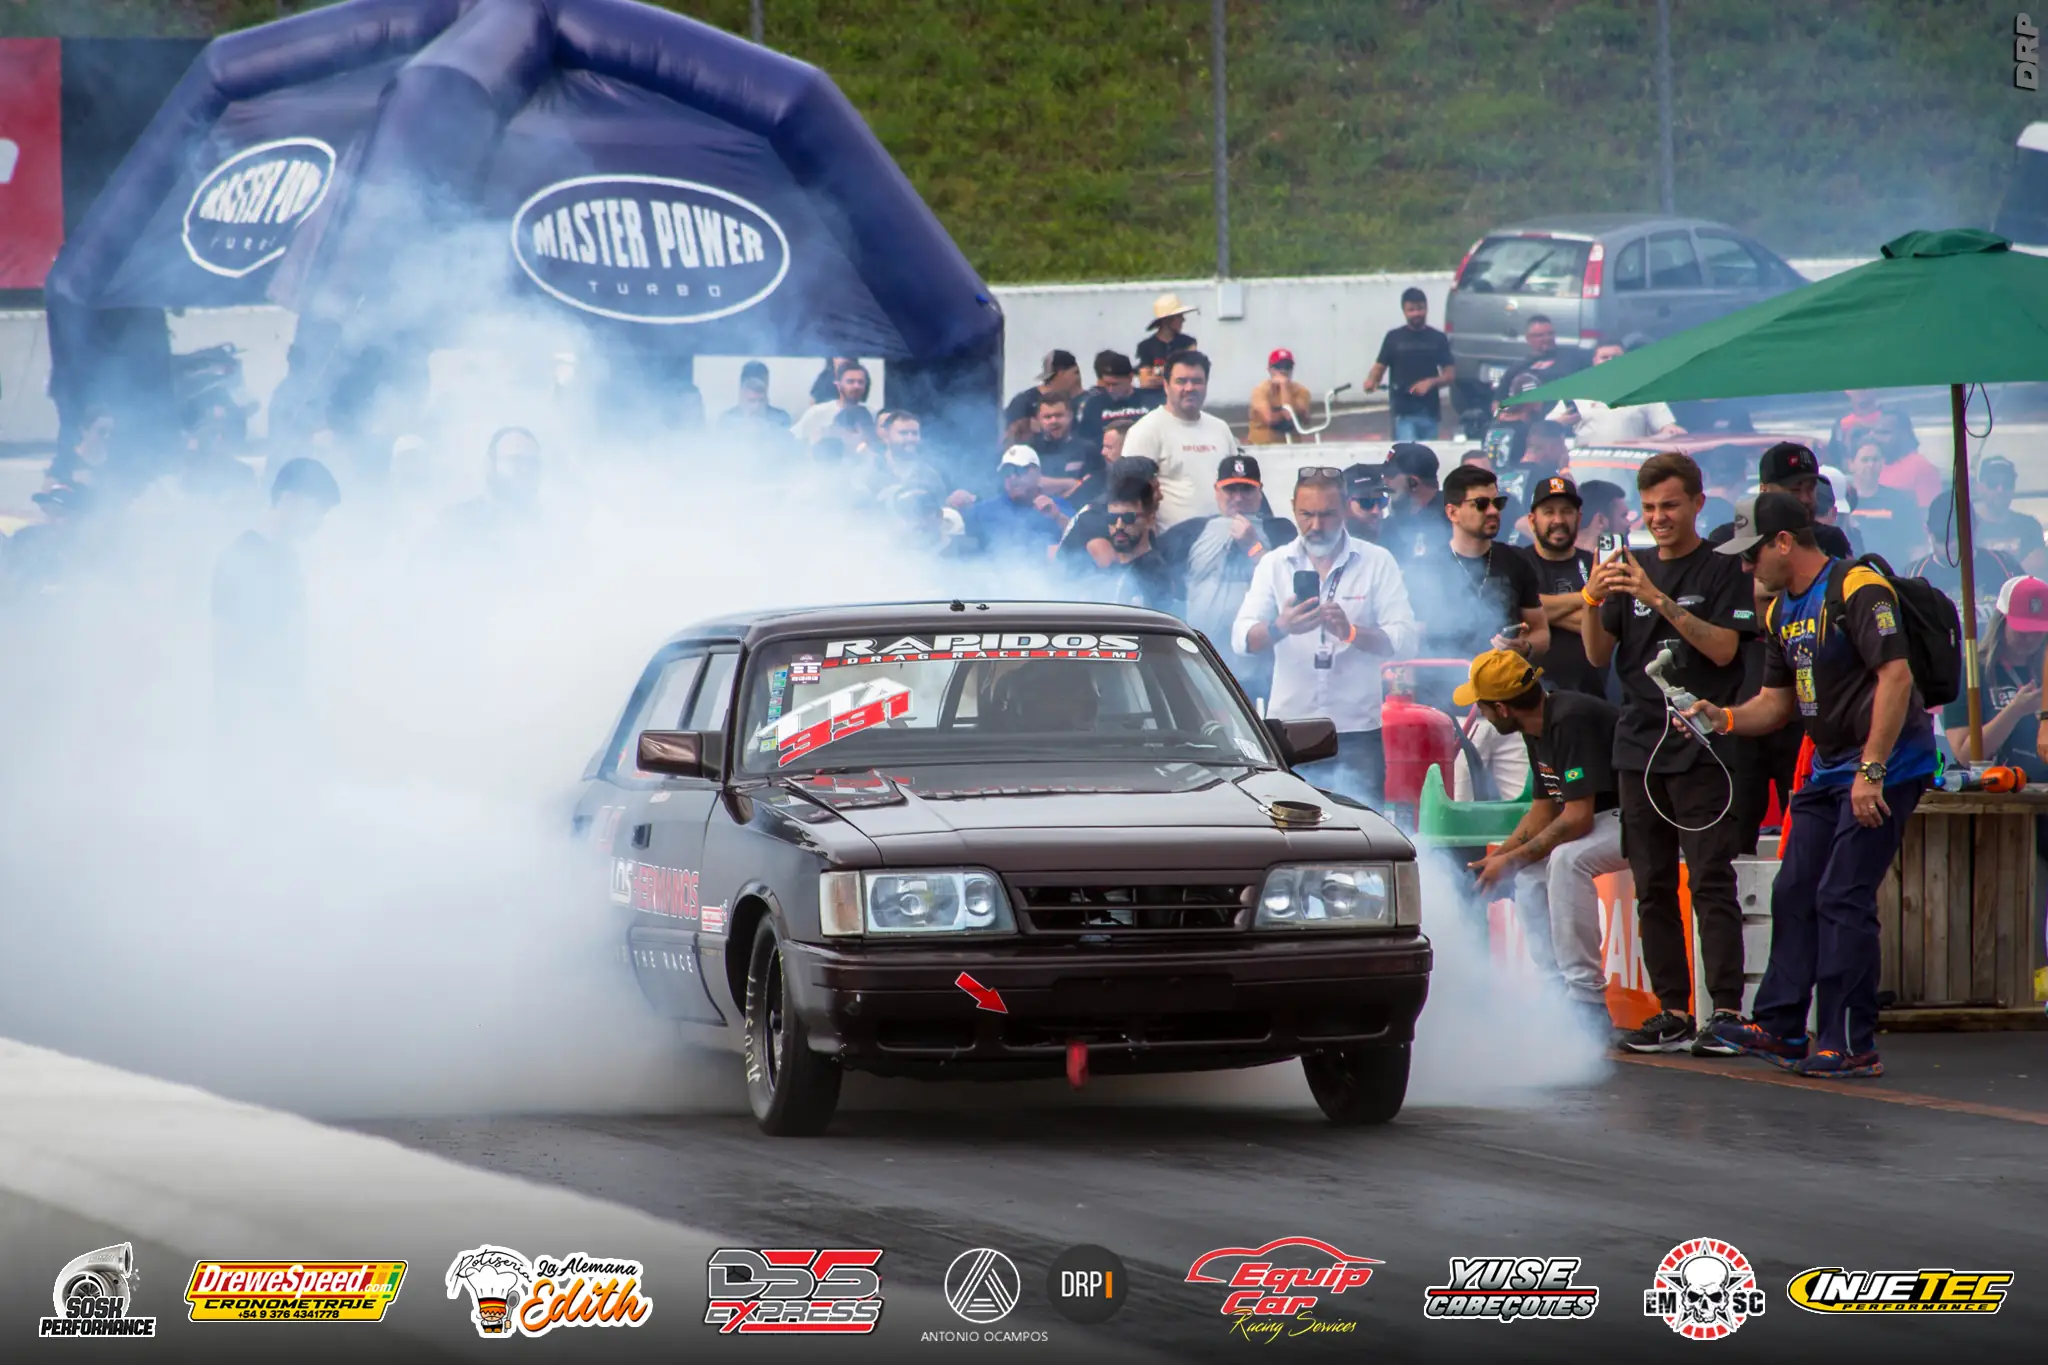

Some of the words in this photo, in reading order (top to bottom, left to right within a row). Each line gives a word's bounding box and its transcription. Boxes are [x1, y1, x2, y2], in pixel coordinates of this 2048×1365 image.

[532, 198, 650, 268] MASTER
[649, 201, 764, 268] POWER
[589, 280, 721, 297] TURBO
[825, 633, 1140, 659] RAPIDOS
[847, 653, 929, 665] DRAG
[952, 650, 1030, 660] RACE
[1047, 650, 1126, 659] TEAM
